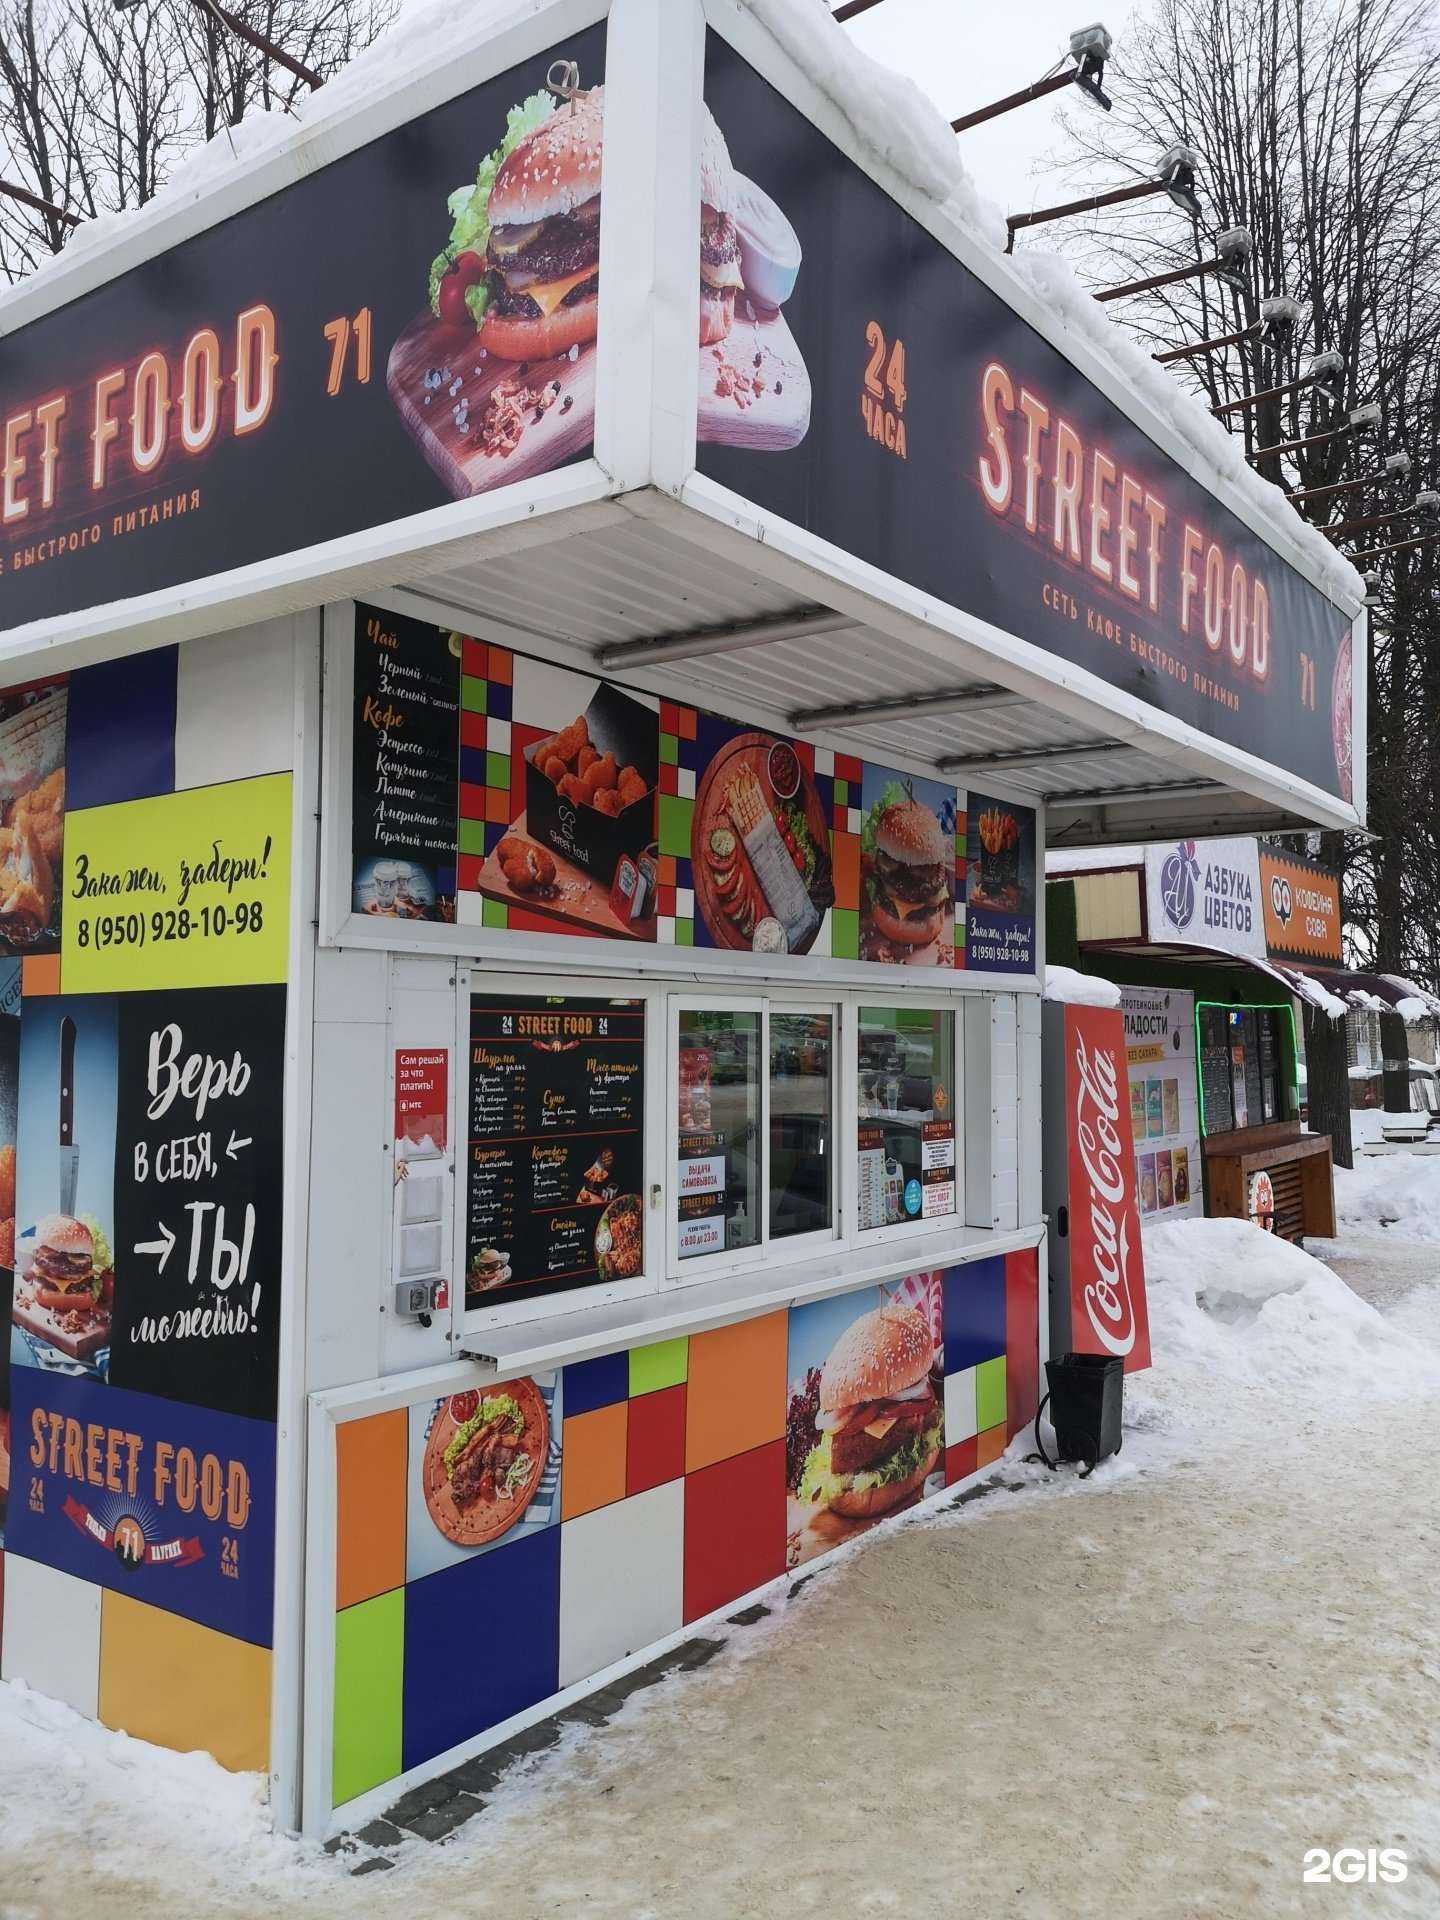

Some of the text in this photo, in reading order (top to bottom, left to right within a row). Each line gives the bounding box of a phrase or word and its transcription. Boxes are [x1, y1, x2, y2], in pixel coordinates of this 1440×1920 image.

[323, 306, 373, 397] 71
[864, 320, 906, 410] 24
[1, 303, 280, 523] ET FOOD
[860, 393, 907, 460] ЧАСА
[13, 524, 101, 570] БЫСТРОГО
[112, 488, 201, 536] ПИТАНИЯ
[977, 361, 1273, 682] STREET FOOD
[366, 617, 400, 649] Чай
[1042, 582, 1241, 712] СЕТЬ КАФЕ БЫСТРОГО ПИТАНИЯ
[378, 653, 423, 681] Черный
[1299, 652, 1319, 711] 71
[377, 674, 428, 704] Зеленый
[363, 695, 404, 731] Кофе
[376, 729, 425, 756] Эспрессо
[375, 751, 429, 782] Капучино
[374, 776, 417, 800] Латте
[373, 800, 440, 826] Американо
[374, 823, 459, 852] Горячий шокола
[71, 834, 273, 907] Закажи, забери!
[1204, 863, 1253, 902] АЗБУКА
[1203, 895, 1253, 933] ЦВЕТОВ
[1294, 887, 1334, 915] КОФЕЙНЯ
[77, 900, 264, 951] 8 (950) 928-10-98
[1305, 917, 1328, 940] СОВА
[971, 945, 1030, 962] 8 (950) 928-10-98
[502, 1015, 513, 1028] 24
[517, 1014, 594, 1036] STREET FOOD
[598, 1017, 609, 1030] 24
[1124, 1014, 1169, 1039] ЛАДОСТИ
[146, 1022, 252, 1122] Верь
[400, 1053, 445, 1067] Сам решай
[400, 1068, 424, 1079] за что
[473, 1047, 516, 1069] Шаурма
[400, 1081, 434, 1092] платить!
[155, 1131, 219, 1183] СЕБЯ,
[688, 1163, 711, 1176] ВЫДАЧА
[681, 1176, 718, 1188] САМОВЫВОЗА
[1075, 1025, 1137, 1357] Coca-Cola
[183, 1200, 257, 1291] ТЫ
[130, 1281, 263, 1344] можешь!
[30, 1407, 253, 1530] STREET FOOD
[30, 1477, 45, 1500] 24
[122, 1527, 139, 1563] 71
[221, 1536, 239, 1564] 24
